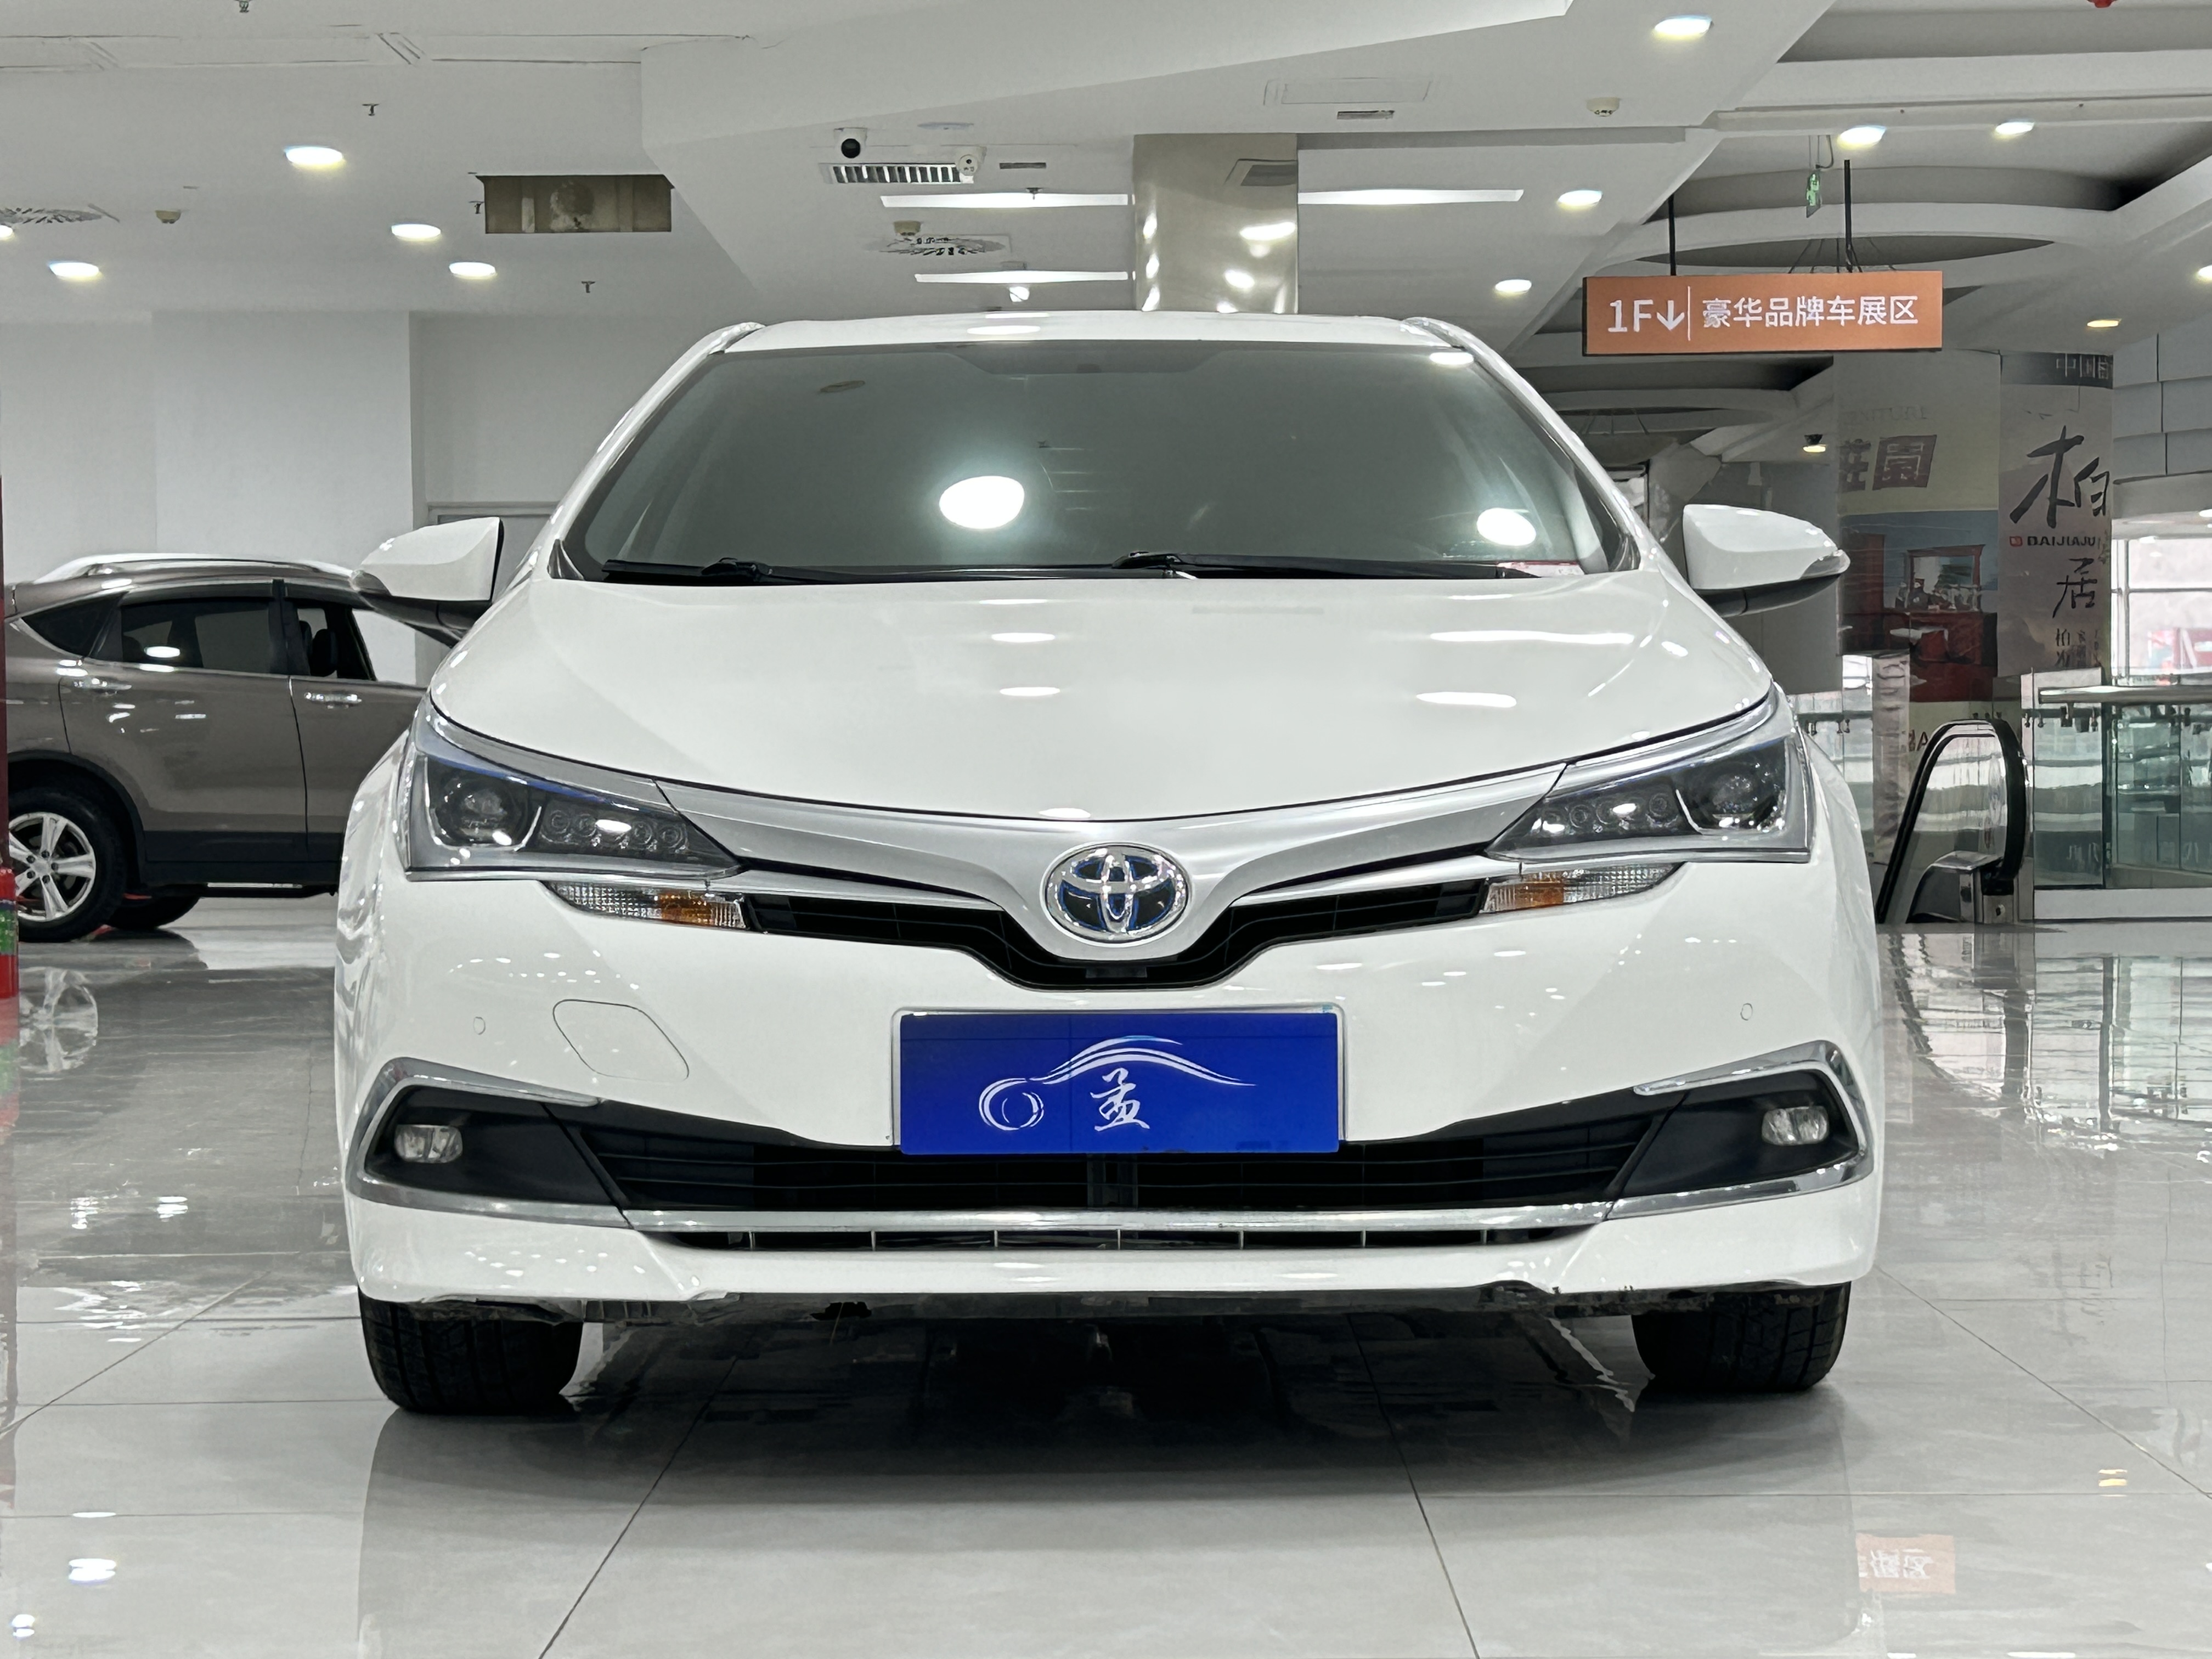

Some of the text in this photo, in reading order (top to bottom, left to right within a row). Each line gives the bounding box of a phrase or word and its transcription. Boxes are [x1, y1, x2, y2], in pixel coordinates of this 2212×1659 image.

[1608, 295, 1919, 332] 1F 豪华品牌车展区
